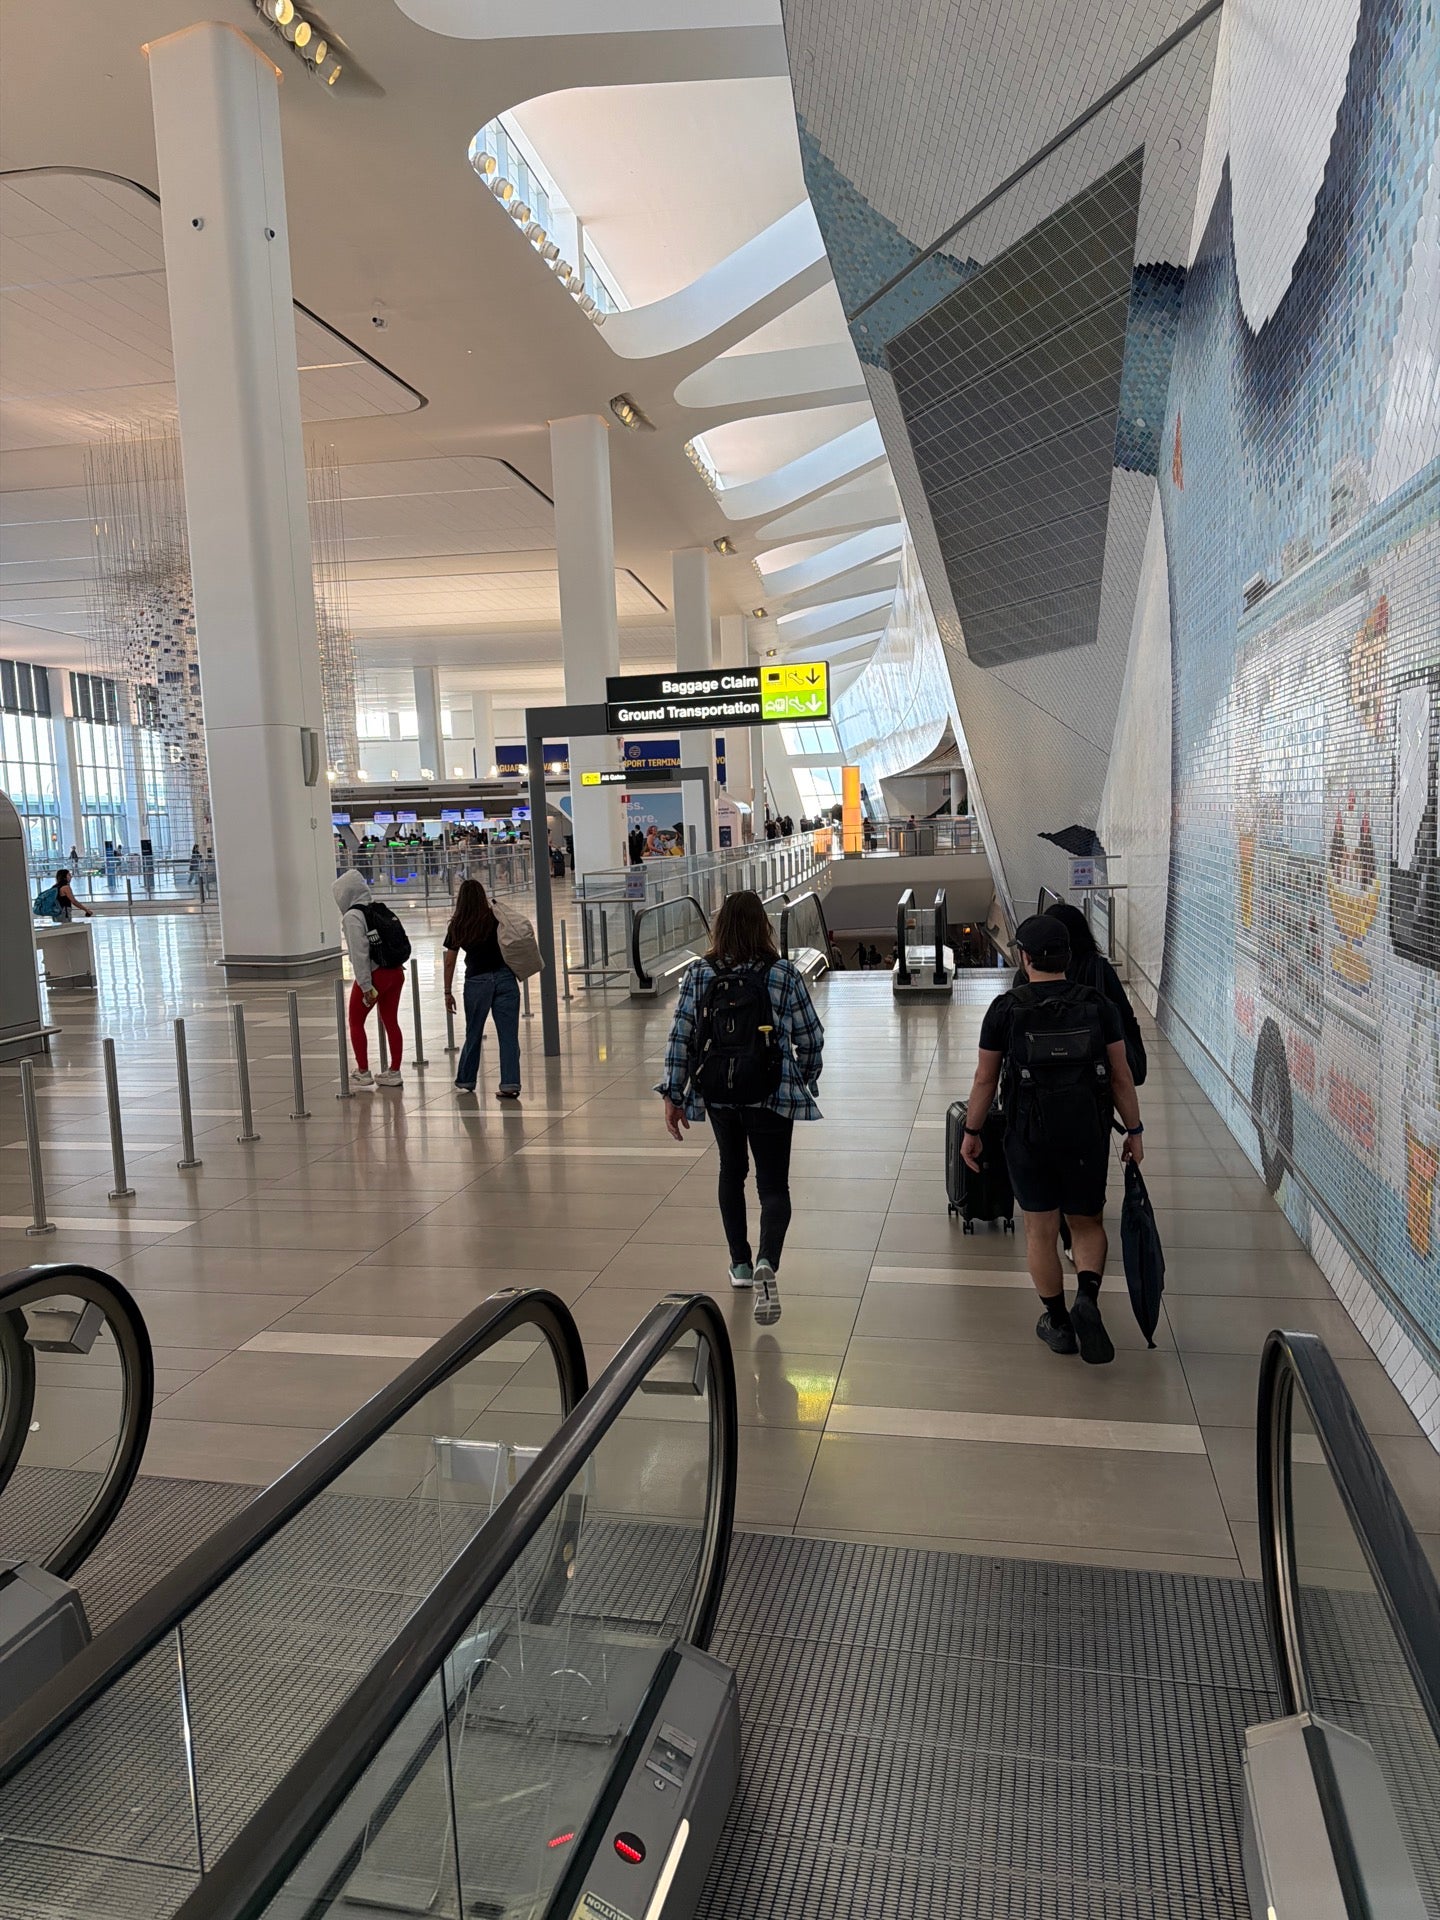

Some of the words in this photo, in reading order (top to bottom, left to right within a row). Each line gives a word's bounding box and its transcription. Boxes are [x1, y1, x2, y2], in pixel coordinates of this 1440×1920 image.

[662, 680, 718, 694] Baggage
[721, 676, 758, 689] Claim
[618, 707, 665, 721] Ground
[667, 702, 759, 719] Transportation
[647, 757, 681, 767] TERMINA
[626, 801, 644, 811] ss.
[586, 1896, 626, 1920] AUTION
